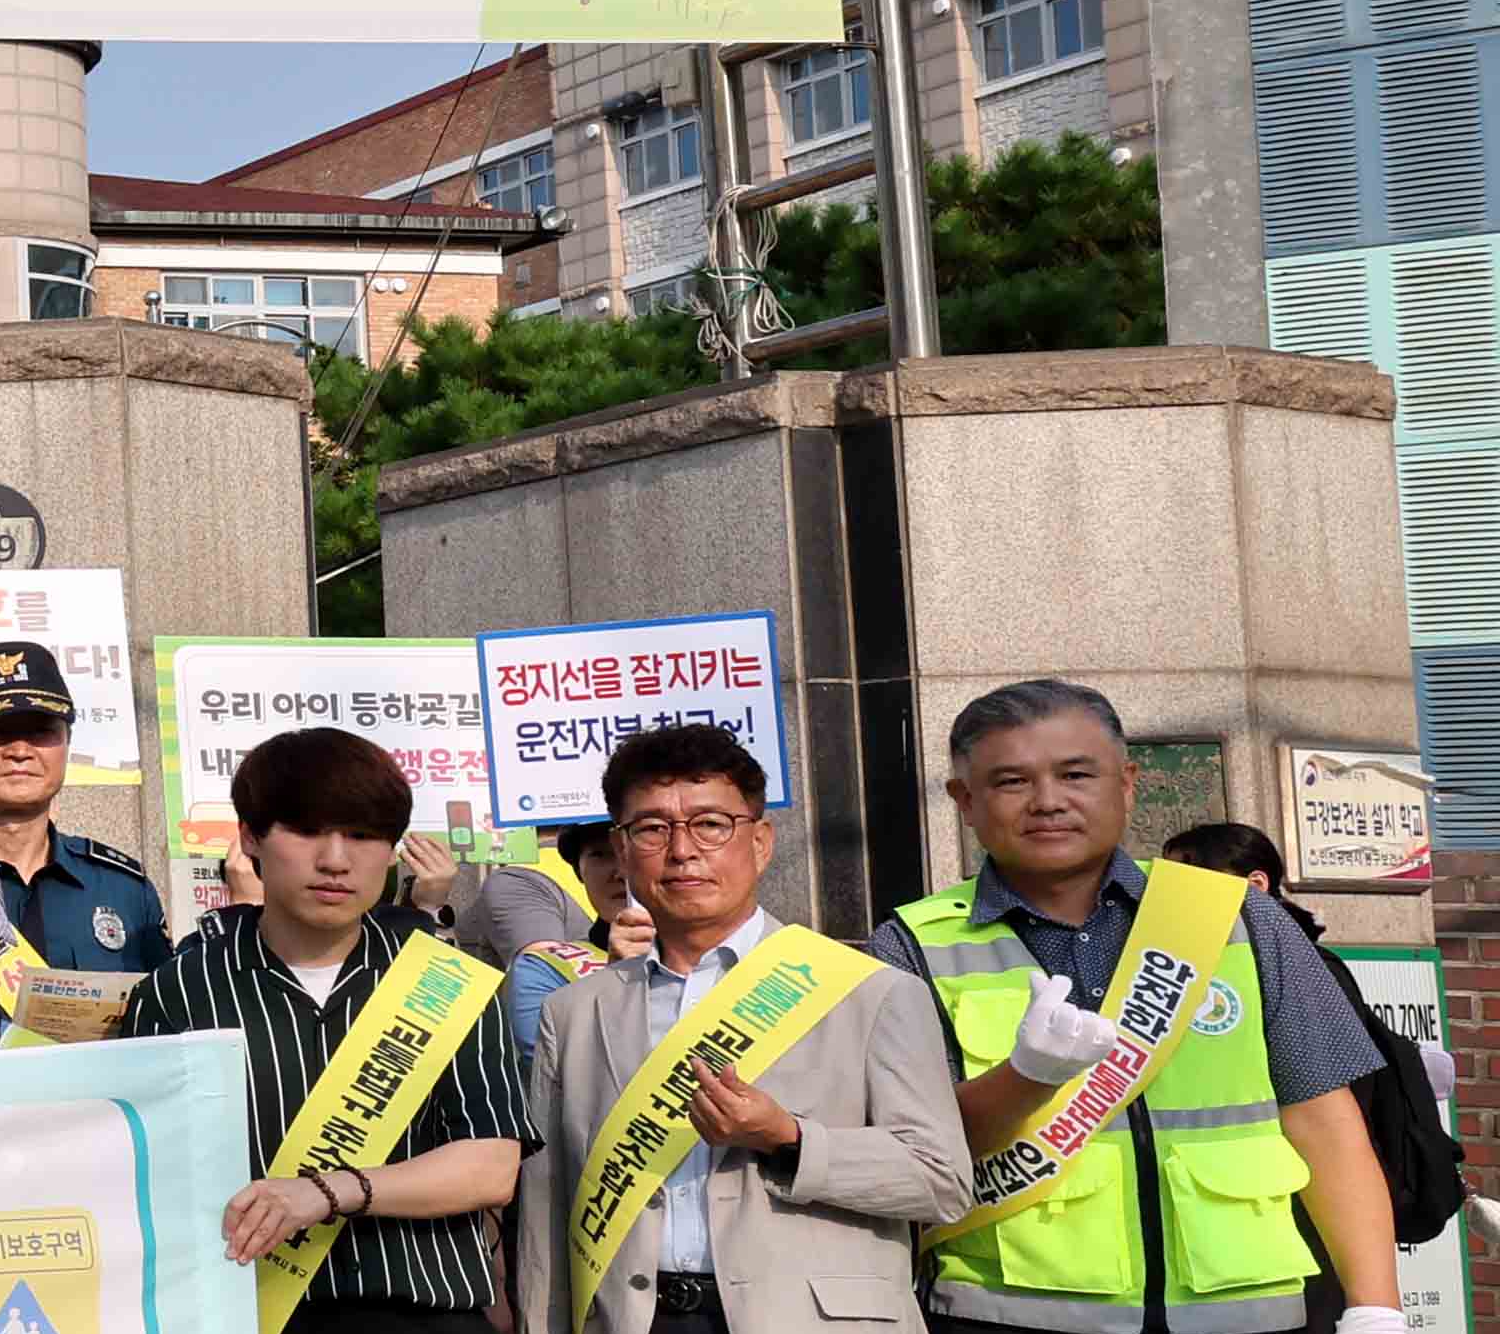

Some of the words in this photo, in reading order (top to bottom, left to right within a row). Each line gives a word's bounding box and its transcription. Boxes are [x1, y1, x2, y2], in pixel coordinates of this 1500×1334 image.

[199, 689, 263, 723] 우리
[272, 692, 340, 722] 아이
[496, 656, 623, 708] 정지선을
[1305, 800, 1368, 836] 구강보건실
[1371, 801, 1397, 837] 설치
[1117, 949, 1196, 1047] 안전한
[1399, 1003, 1439, 1042] ZONE
[341, 1015, 434, 1122] 교통법규
[579, 1112, 669, 1244] 준수합시다
